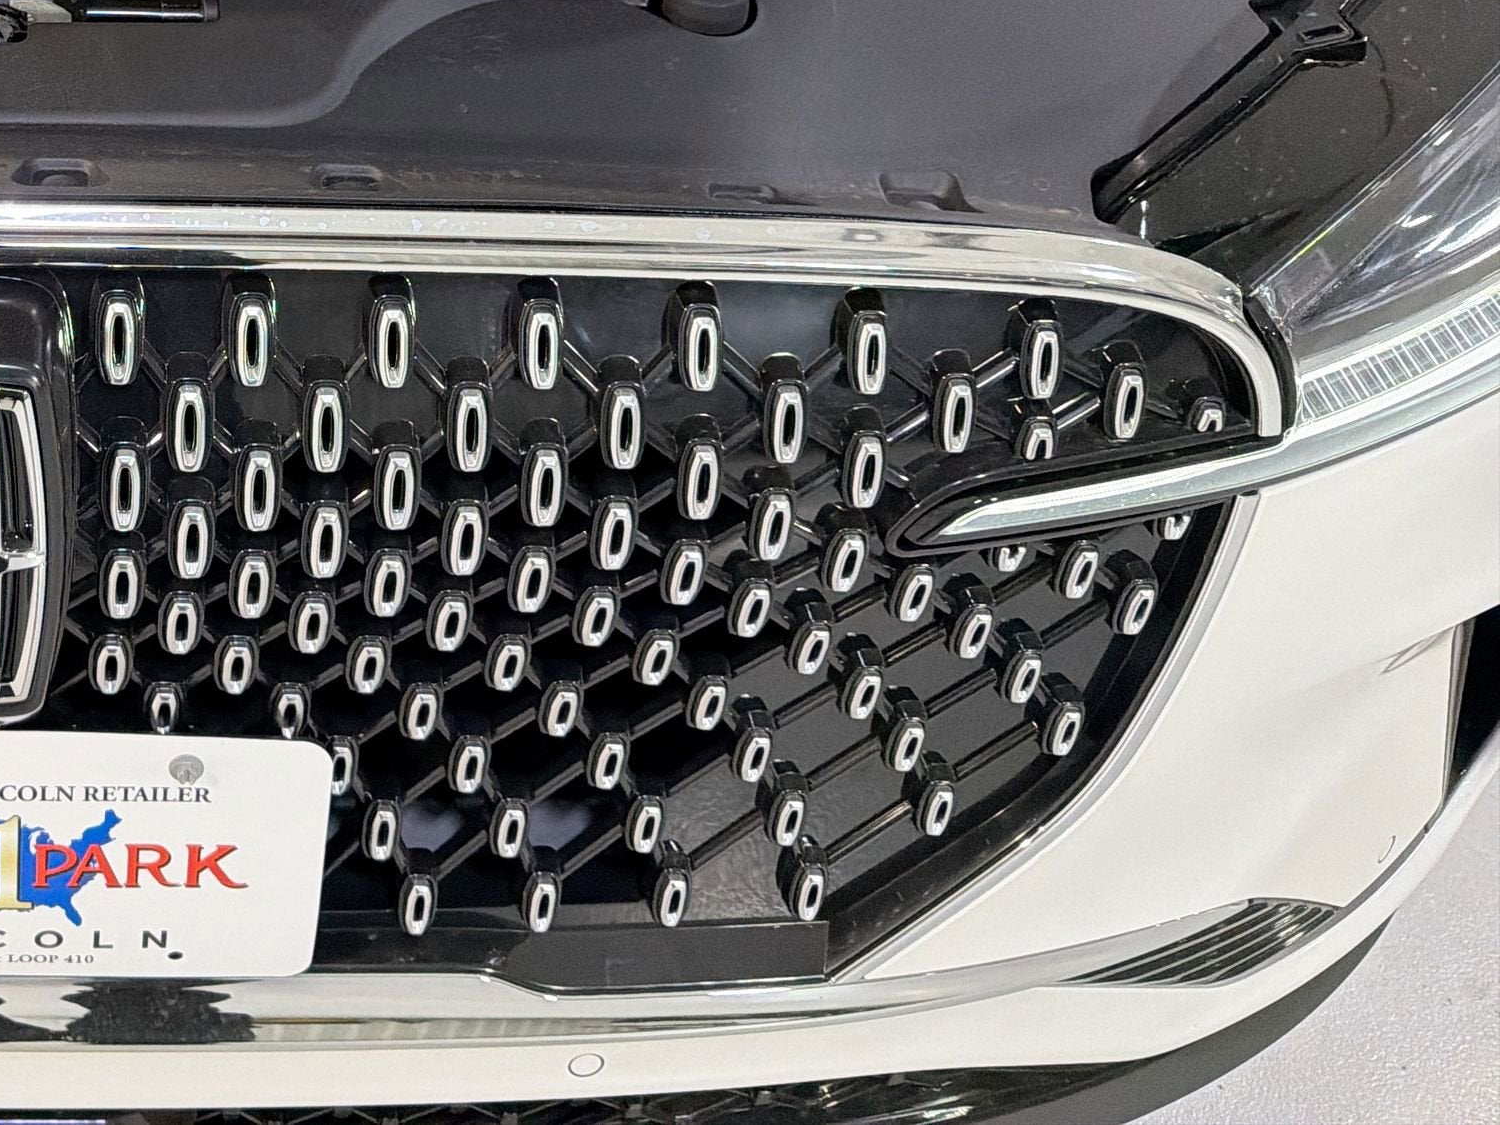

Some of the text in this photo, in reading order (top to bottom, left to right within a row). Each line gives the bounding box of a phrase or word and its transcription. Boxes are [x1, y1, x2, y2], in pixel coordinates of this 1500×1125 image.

[83, 786, 212, 803] RETAILER
[32, 843, 249, 889] PARK
[7, 953, 60, 963] LOOP
[63, 953, 95, 964] 410
